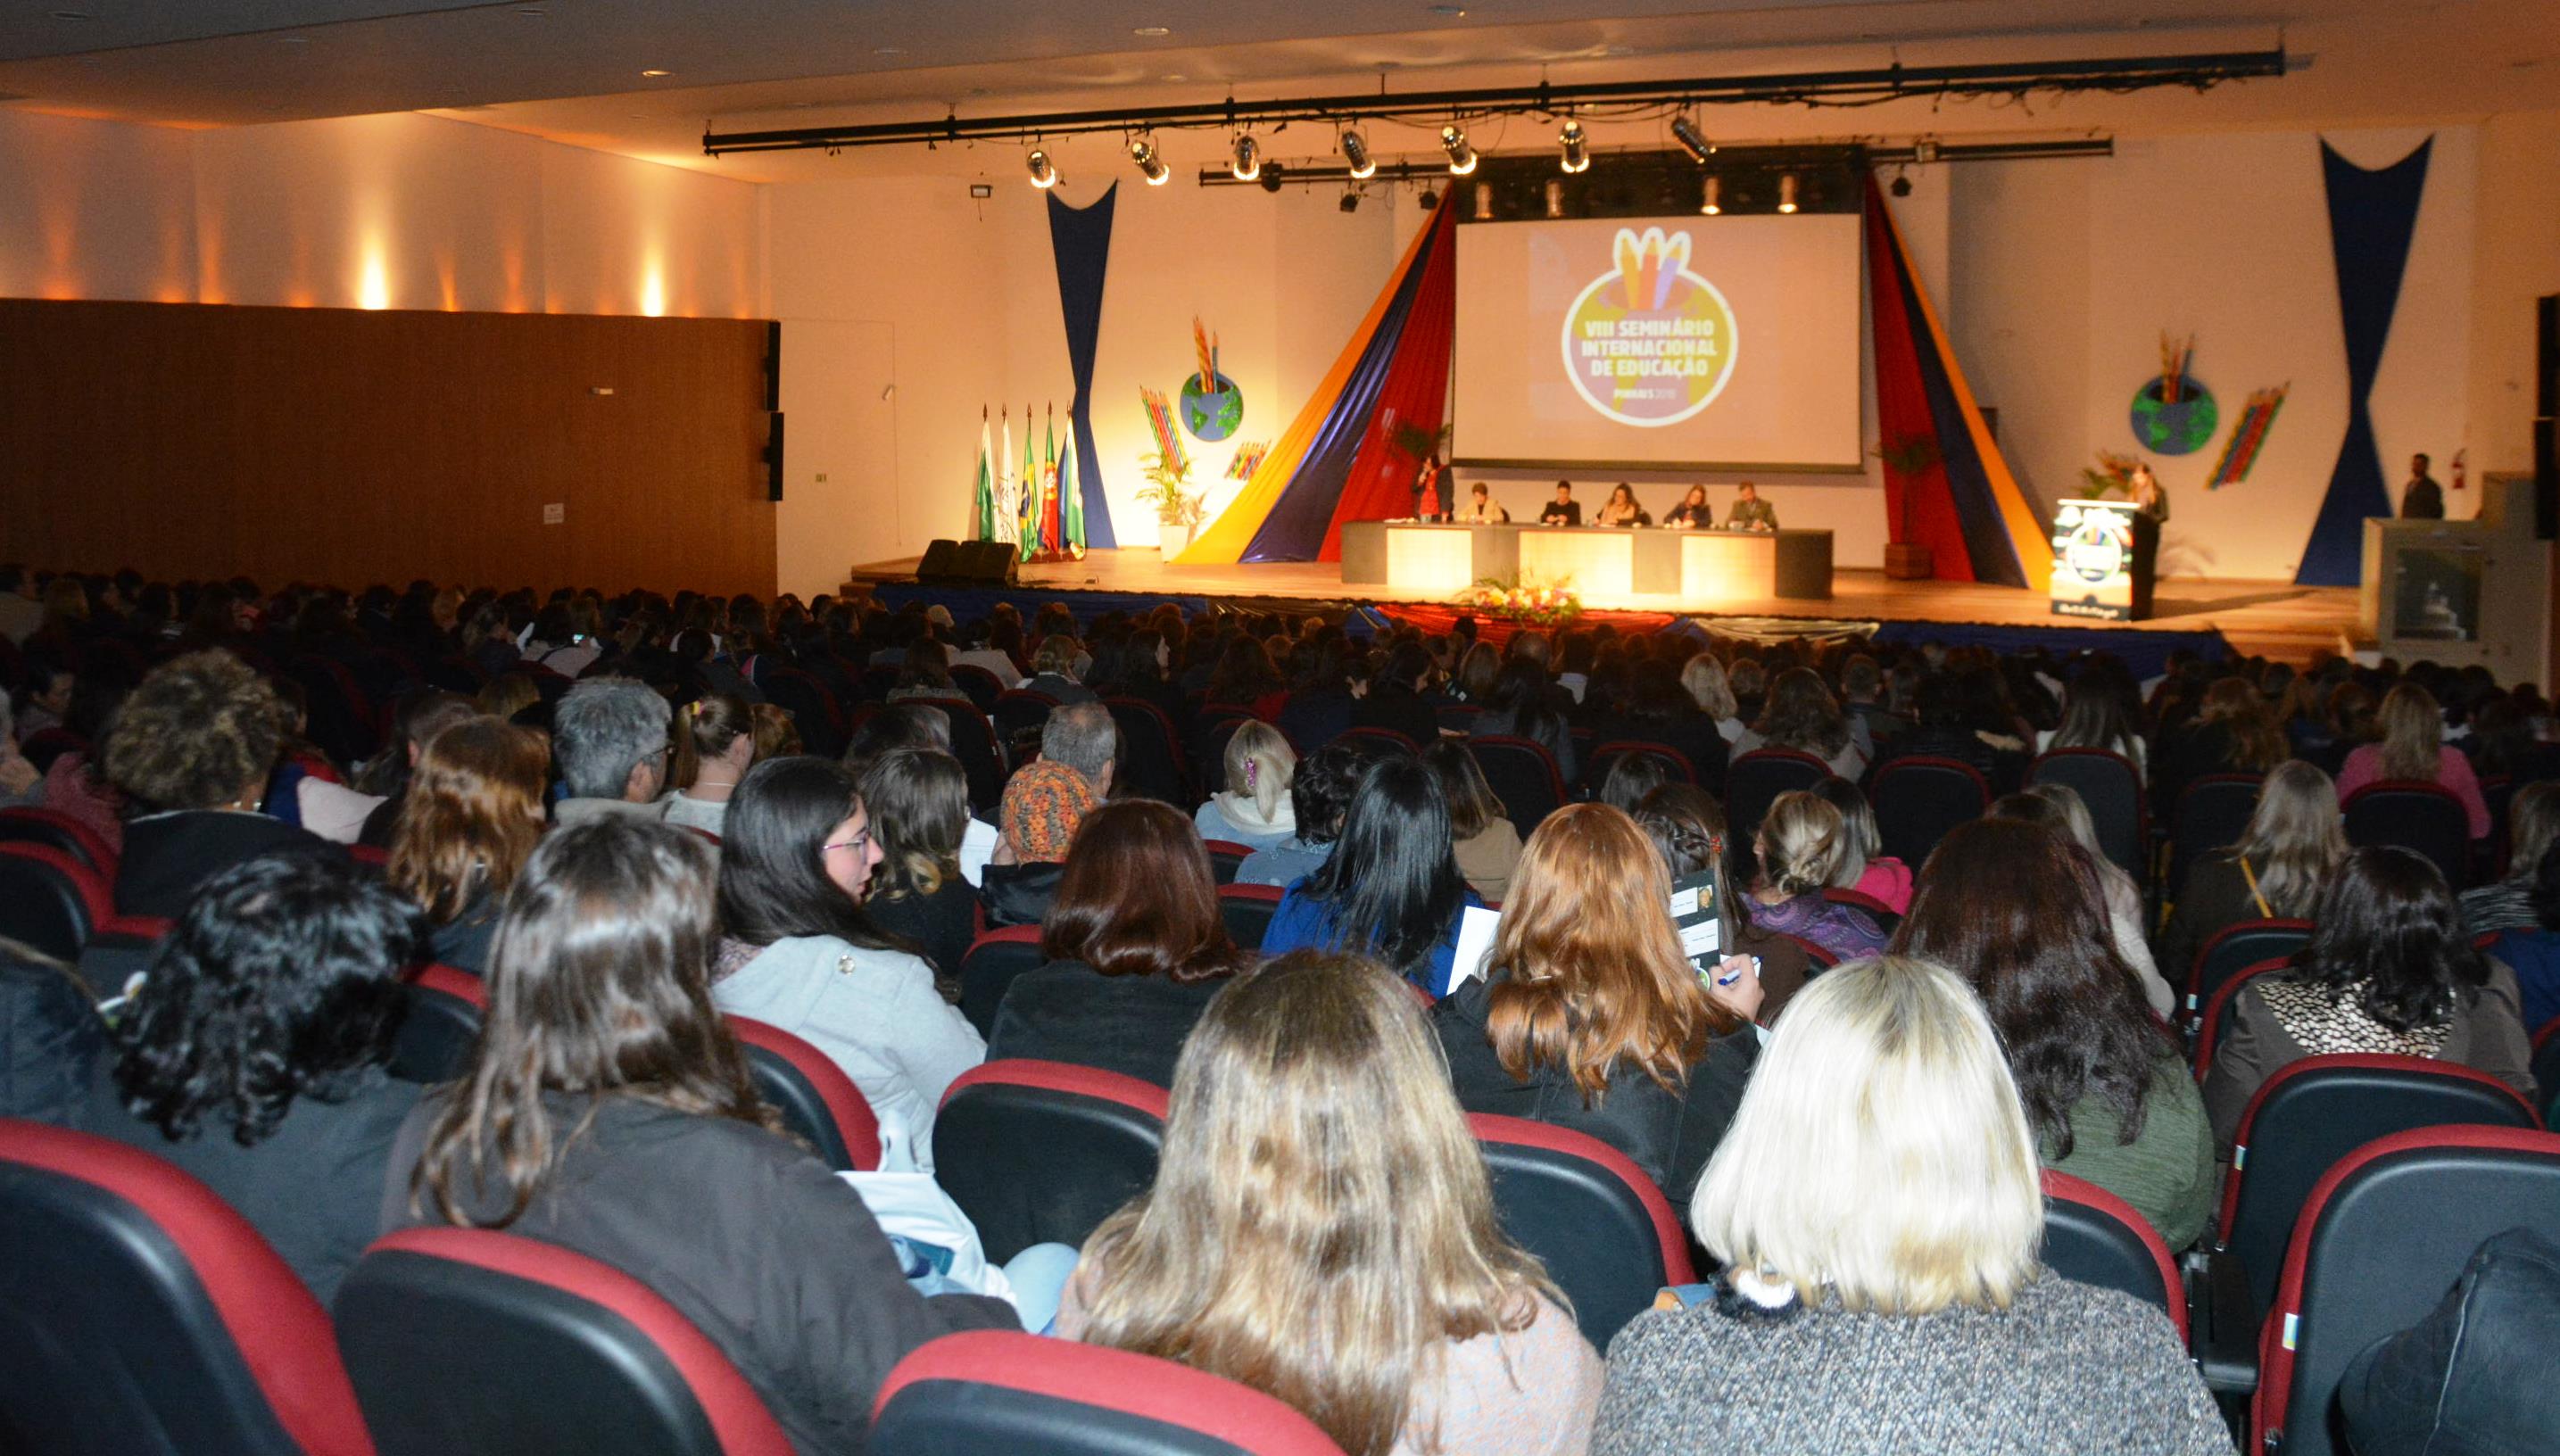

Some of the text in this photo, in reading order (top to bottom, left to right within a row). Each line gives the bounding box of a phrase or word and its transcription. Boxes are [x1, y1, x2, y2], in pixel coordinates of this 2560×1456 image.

[1585, 316, 1715, 337] VIII SEMINÁRIO
[1581, 339, 1718, 357] INTERNACIONAL
[1591, 356, 1708, 379] DE EDUCAÇÃO
